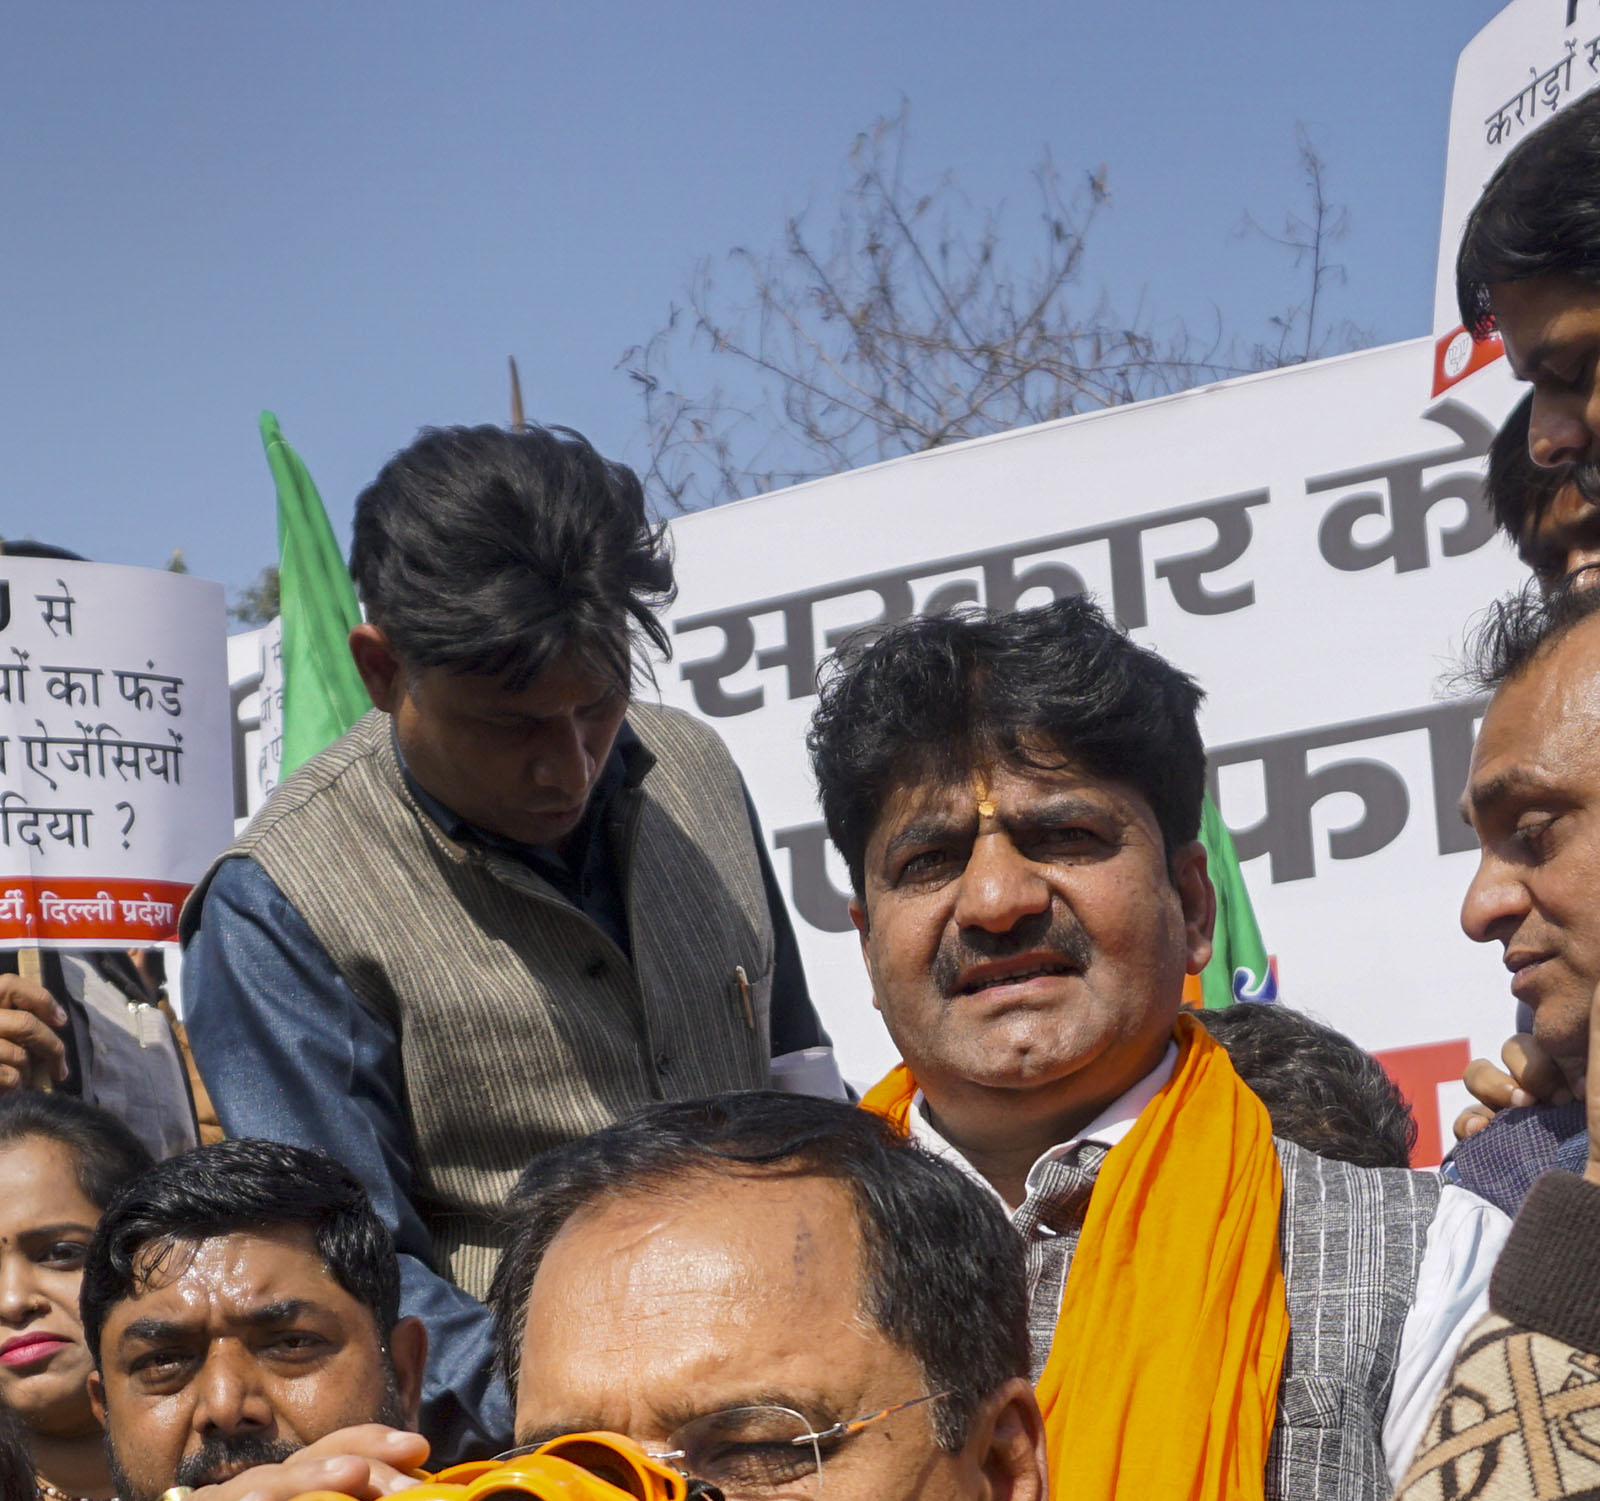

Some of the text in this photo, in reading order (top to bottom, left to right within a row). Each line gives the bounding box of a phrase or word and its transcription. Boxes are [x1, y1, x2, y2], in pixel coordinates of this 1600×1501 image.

[1485, 38, 1578, 145] करोड़ों
[34, 578, 75, 637] से
[40, 664, 103, 708] का
[112, 659, 184, 716] फंड
[116, 801, 137, 850] ?
[39, 892, 113, 924] दिल्ली
[116, 897, 174, 927] प्रदेश
